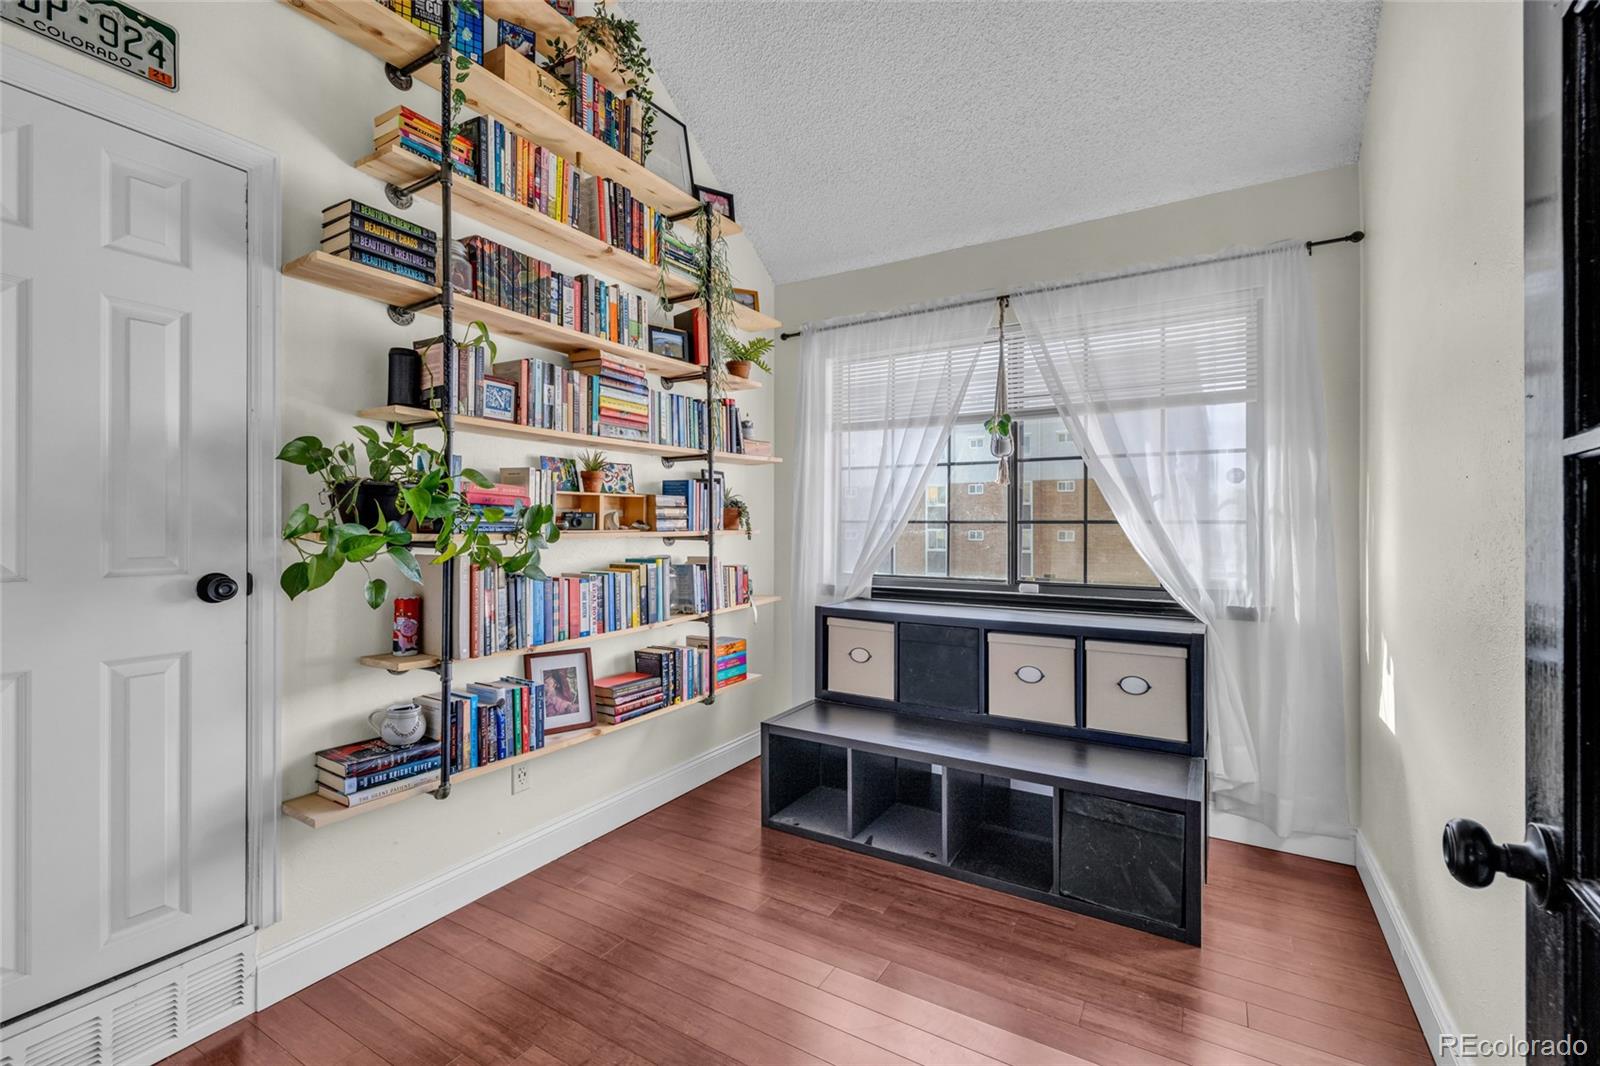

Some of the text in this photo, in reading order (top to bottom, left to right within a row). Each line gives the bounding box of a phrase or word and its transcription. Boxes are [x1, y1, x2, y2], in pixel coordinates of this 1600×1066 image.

[34, 20, 132, 68] COLORADO
[361, 204, 390, 225] BEAUTIFUL
[364, 220, 418, 249] BEAUTIFUL CHAOS
[360, 236, 427, 268] BEAUTIFUL CREATURES
[361, 252, 395, 272] BEAUTIFUL
[371, 773, 387, 784] LONG
[389, 767, 412, 779] BRIGHT
[414, 761, 432, 772] RIVER
